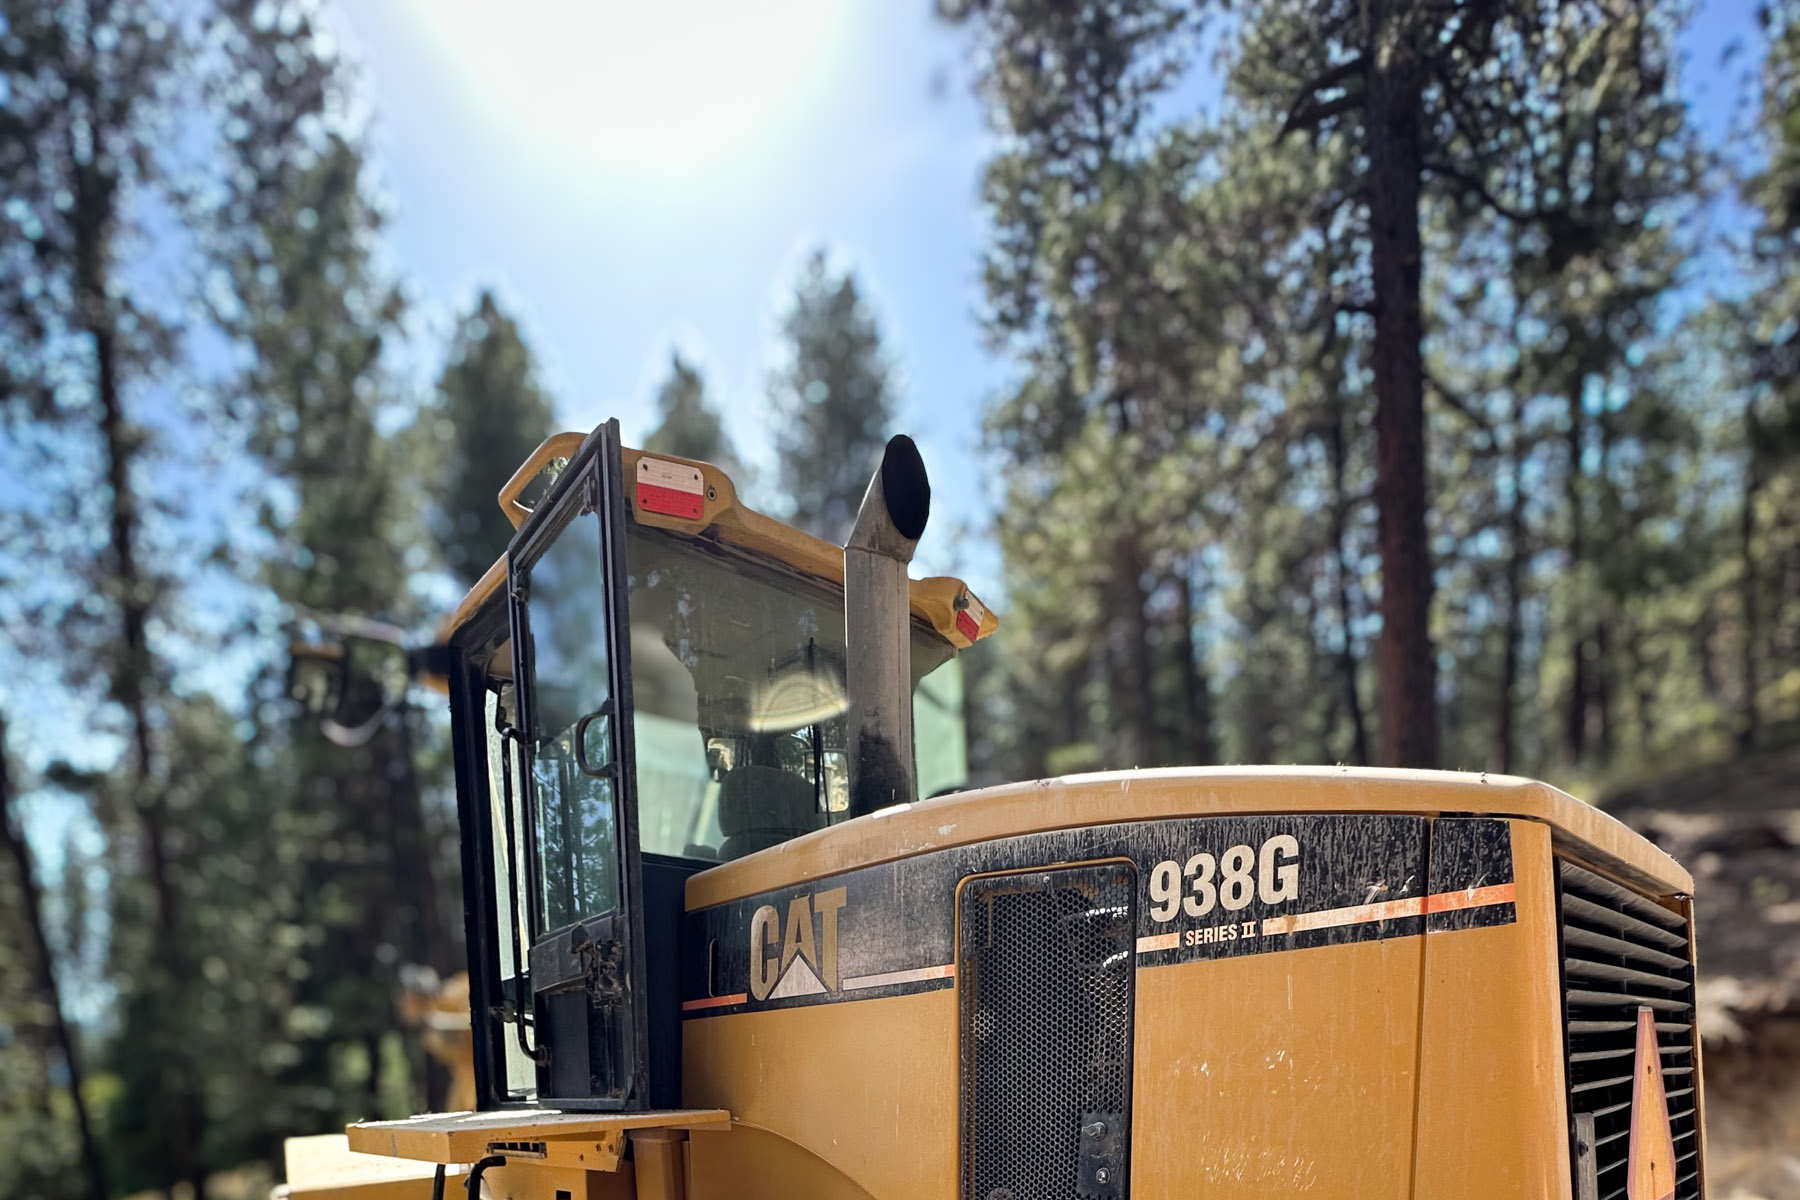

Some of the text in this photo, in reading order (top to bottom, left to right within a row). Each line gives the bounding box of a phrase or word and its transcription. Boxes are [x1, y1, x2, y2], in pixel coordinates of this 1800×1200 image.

[1150, 834, 1299, 923] 938G
[750, 886, 847, 1001] CAT
[1185, 920, 1257, 947] SERIES II
